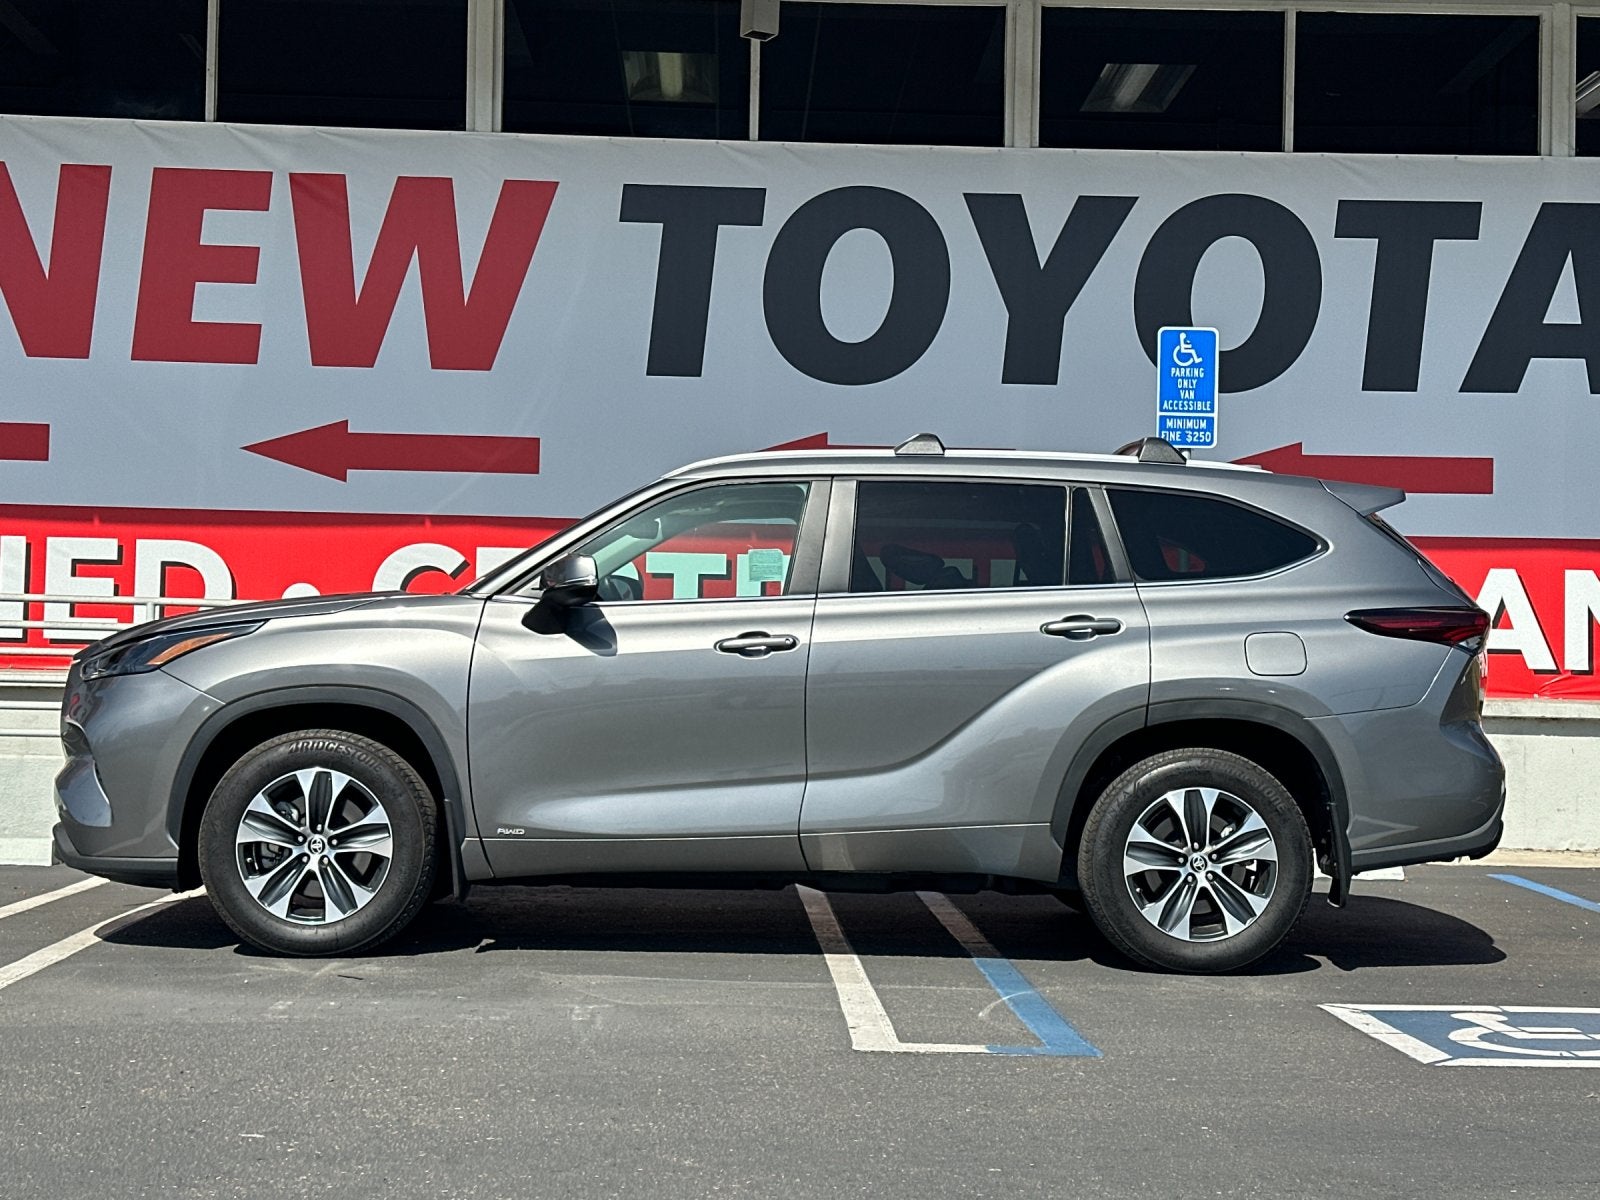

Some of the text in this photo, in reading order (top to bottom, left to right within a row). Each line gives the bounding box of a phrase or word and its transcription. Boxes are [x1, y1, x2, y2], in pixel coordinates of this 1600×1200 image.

[0, 160, 1600, 394] NEW TOYOTA
[1170, 367, 1204, 378] PARKING
[1177, 378, 1197, 389] ONLY
[1180, 389, 1195, 400] VAN
[1162, 400, 1211, 411] ACCESSIBLE
[1166, 418, 1207, 429] MINIMUM
[1161, 430, 1212, 443] FINE $250
[497, 827, 525, 835] AWD
